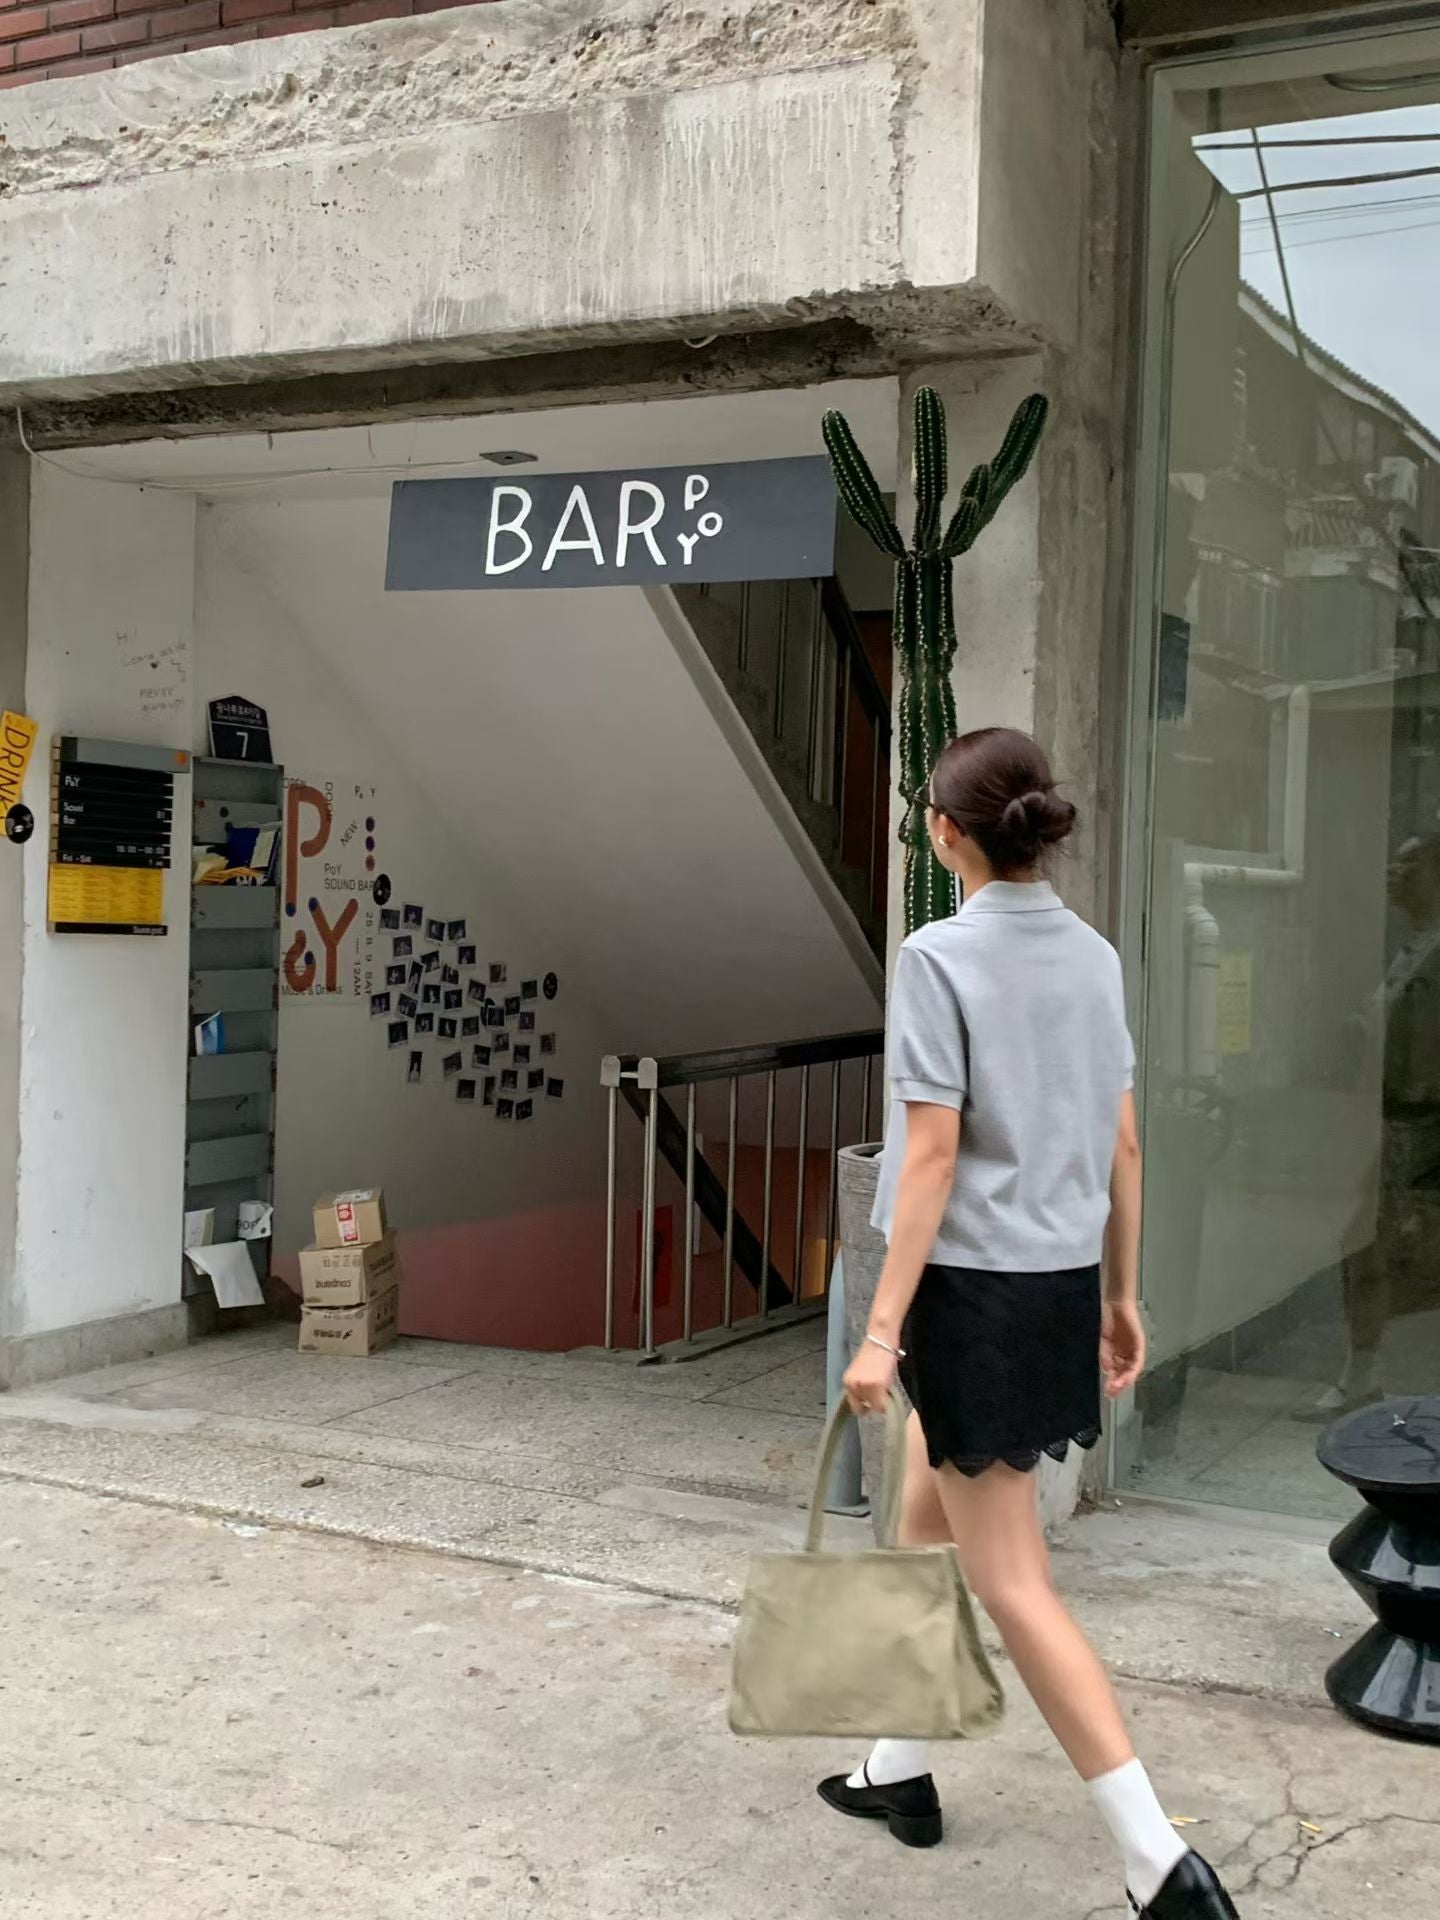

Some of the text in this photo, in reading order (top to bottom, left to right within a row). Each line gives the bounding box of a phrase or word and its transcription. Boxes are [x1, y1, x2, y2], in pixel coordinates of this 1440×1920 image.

[485, 480, 667, 575] BAR
[236, 731, 249, 758] 7
[340, 819, 360, 847] NEW
[324, 878, 356, 891] SOUND
